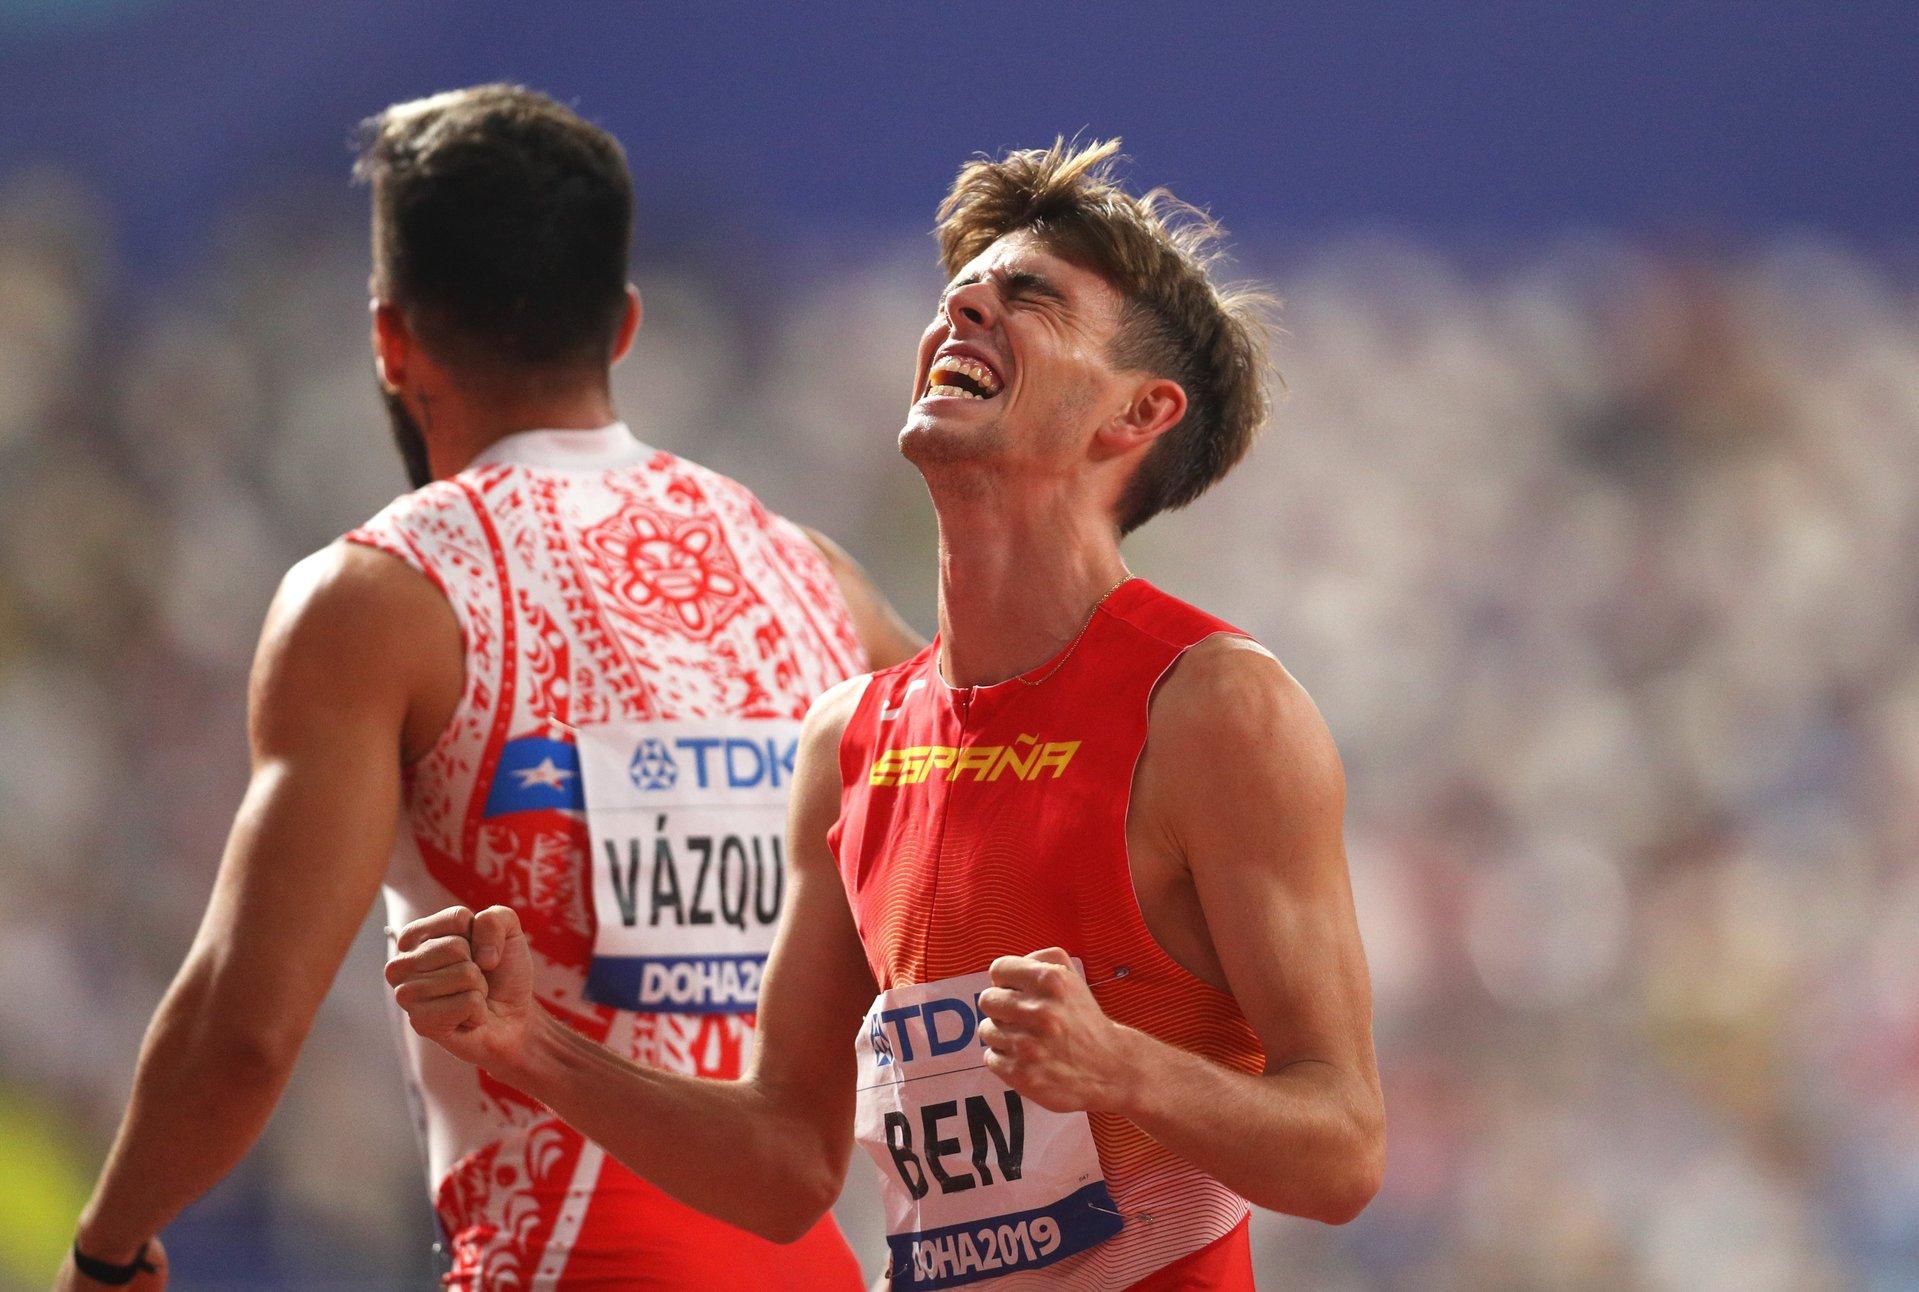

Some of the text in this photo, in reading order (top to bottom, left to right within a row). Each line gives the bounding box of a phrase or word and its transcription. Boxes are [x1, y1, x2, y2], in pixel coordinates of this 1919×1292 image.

[675, 737, 799, 788] TDK
[868, 733, 1082, 787] ESPAÑA
[640, 960, 767, 1004] DOHA2
[884, 1090, 1024, 1200] BEN
[912, 1216, 1062, 1282] DOHA2019
